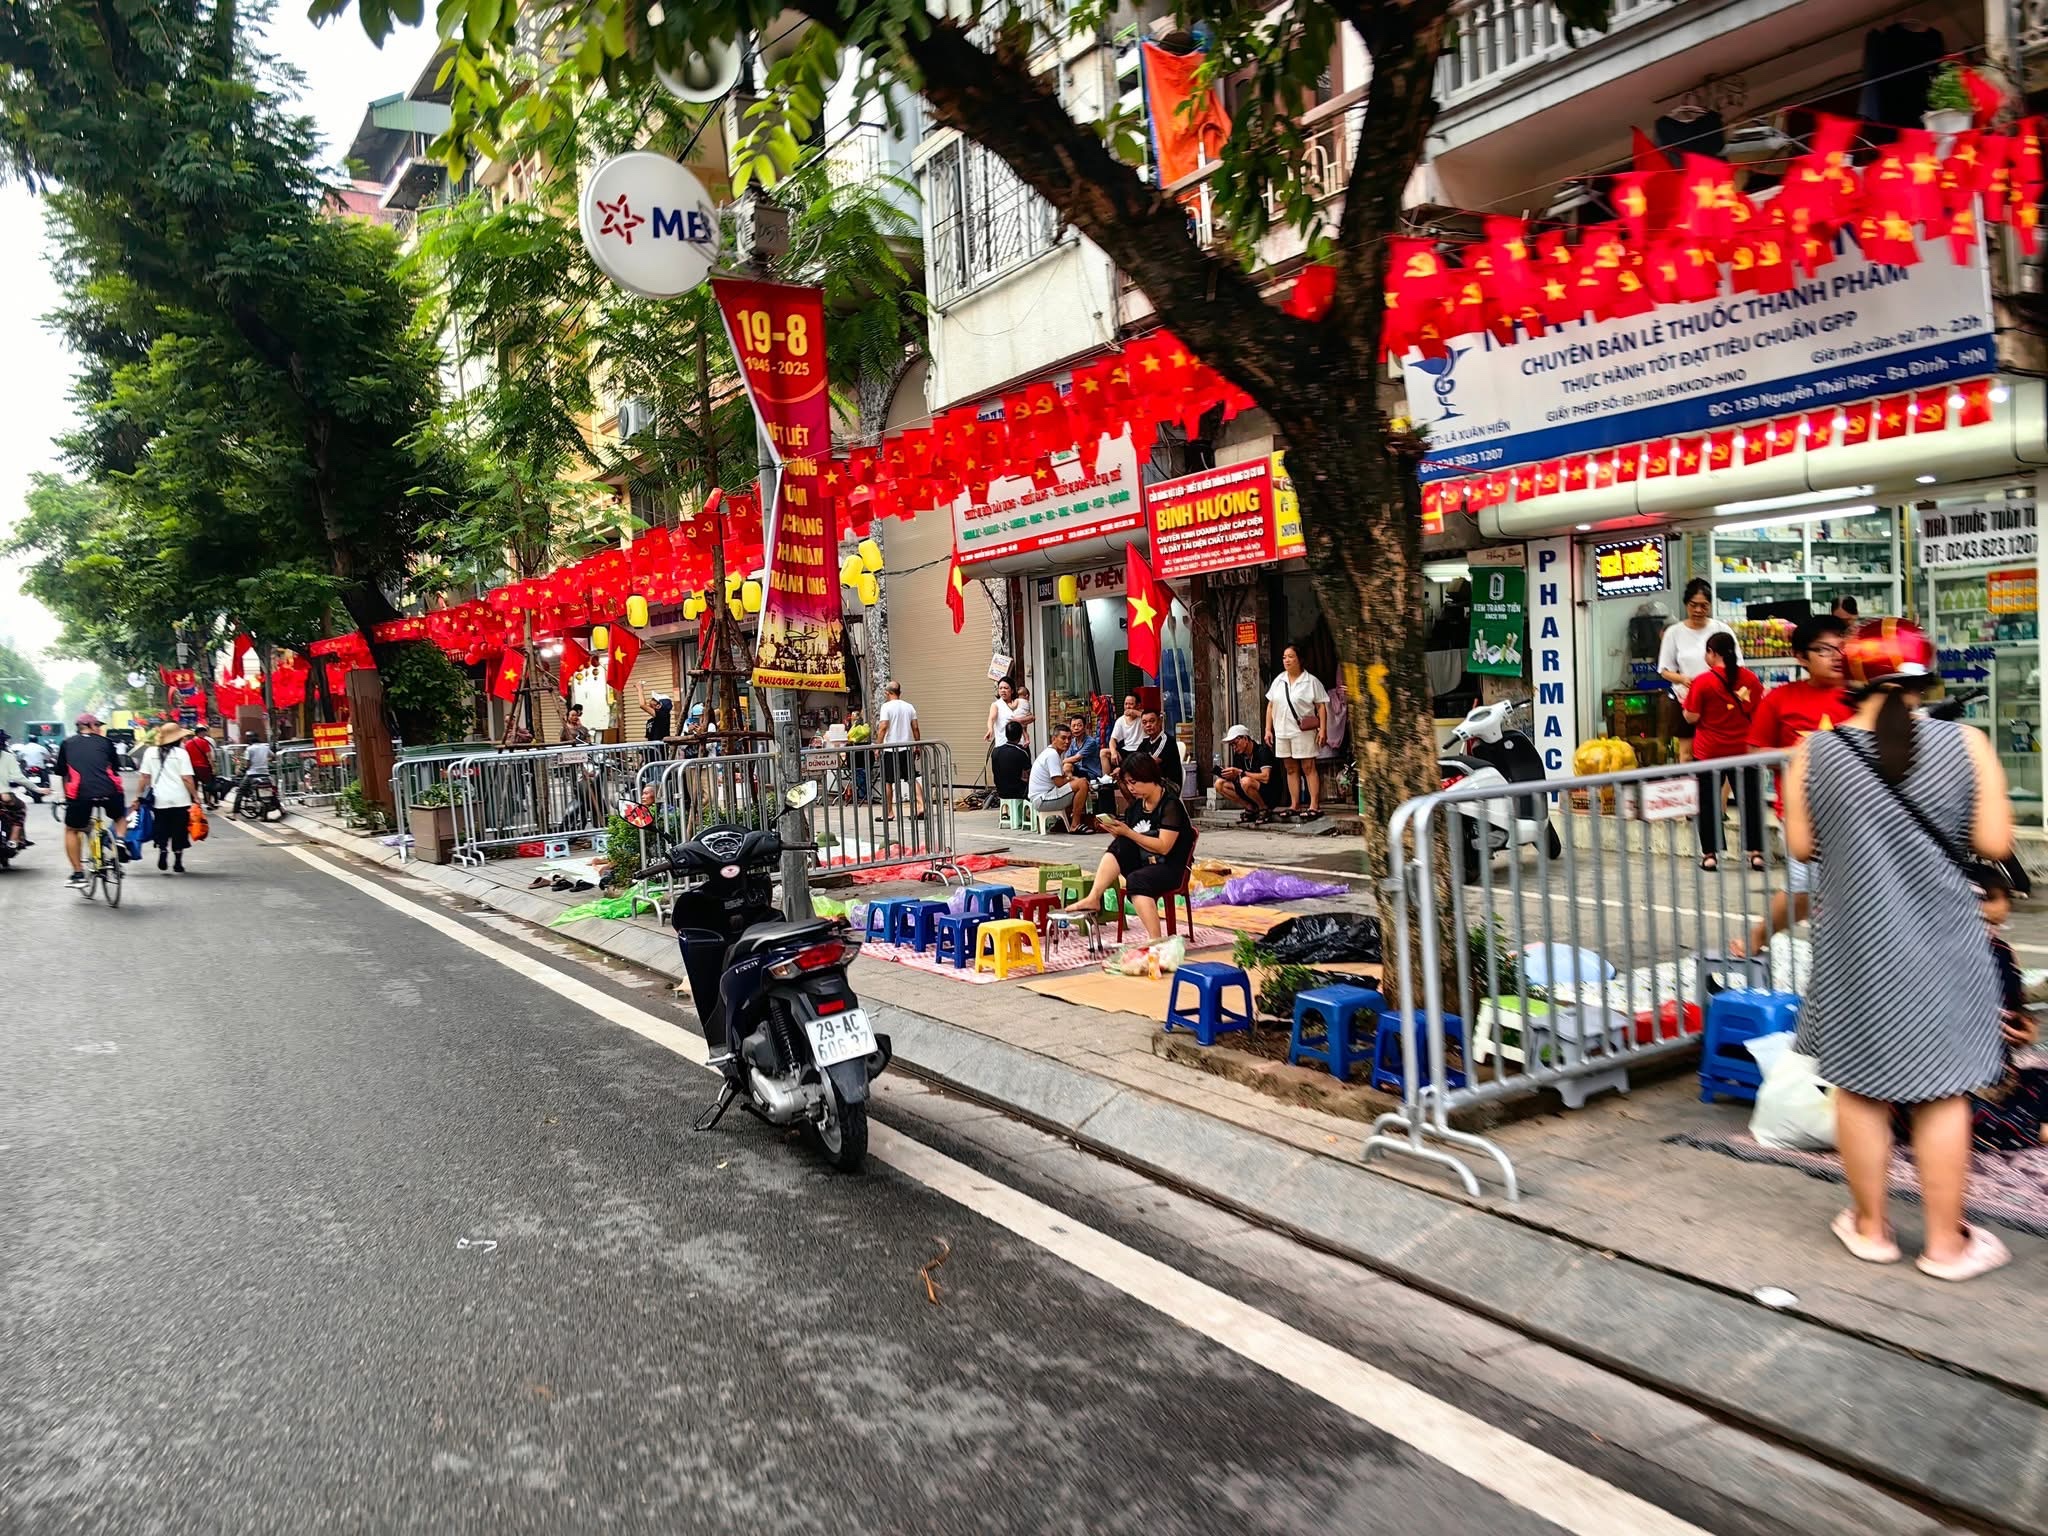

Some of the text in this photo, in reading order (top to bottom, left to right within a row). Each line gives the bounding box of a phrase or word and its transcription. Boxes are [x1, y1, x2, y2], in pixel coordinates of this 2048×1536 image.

[652, 206, 712, 244] MB
[737, 309, 808, 356] 19-8
[1948, 314, 1983, 333] 22h
[1521, 341, 1592, 376] CHUYÊN
[1598, 328, 1638, 358] BÁN
[1641, 320, 1664, 347] LẺ
[1667, 300, 1743, 340] THUỐC
[1561, 310, 1858, 394] THỰC HÀNH TỐT ĐẠT TIÊU CHUẨN GPP
[1957, 347, 1988, 367] HN
[1479, 447, 1504, 463] 1207
[1155, 501, 1194, 532] BÌNH
[1195, 488, 1261, 523] HƯƠNG
[1950, 507, 1988, 535] THUỐC
[1156, 533, 1180, 545] CHUYÊN
[1180, 529, 1196, 540] KINH
[1196, 525, 1218, 537] DOANH
[1232, 518, 1247, 530] CÁP
[1159, 544, 1169, 555] VÀ
[1207, 533, 1225, 545] CHẤT
[1225, 530, 1248, 543] LƯỢNG
[1248, 527, 1264, 538] CAO
[1075, 565, 1125, 591] ÁP ĐIỆN
[816, 1013, 860, 1041] 29-AC
